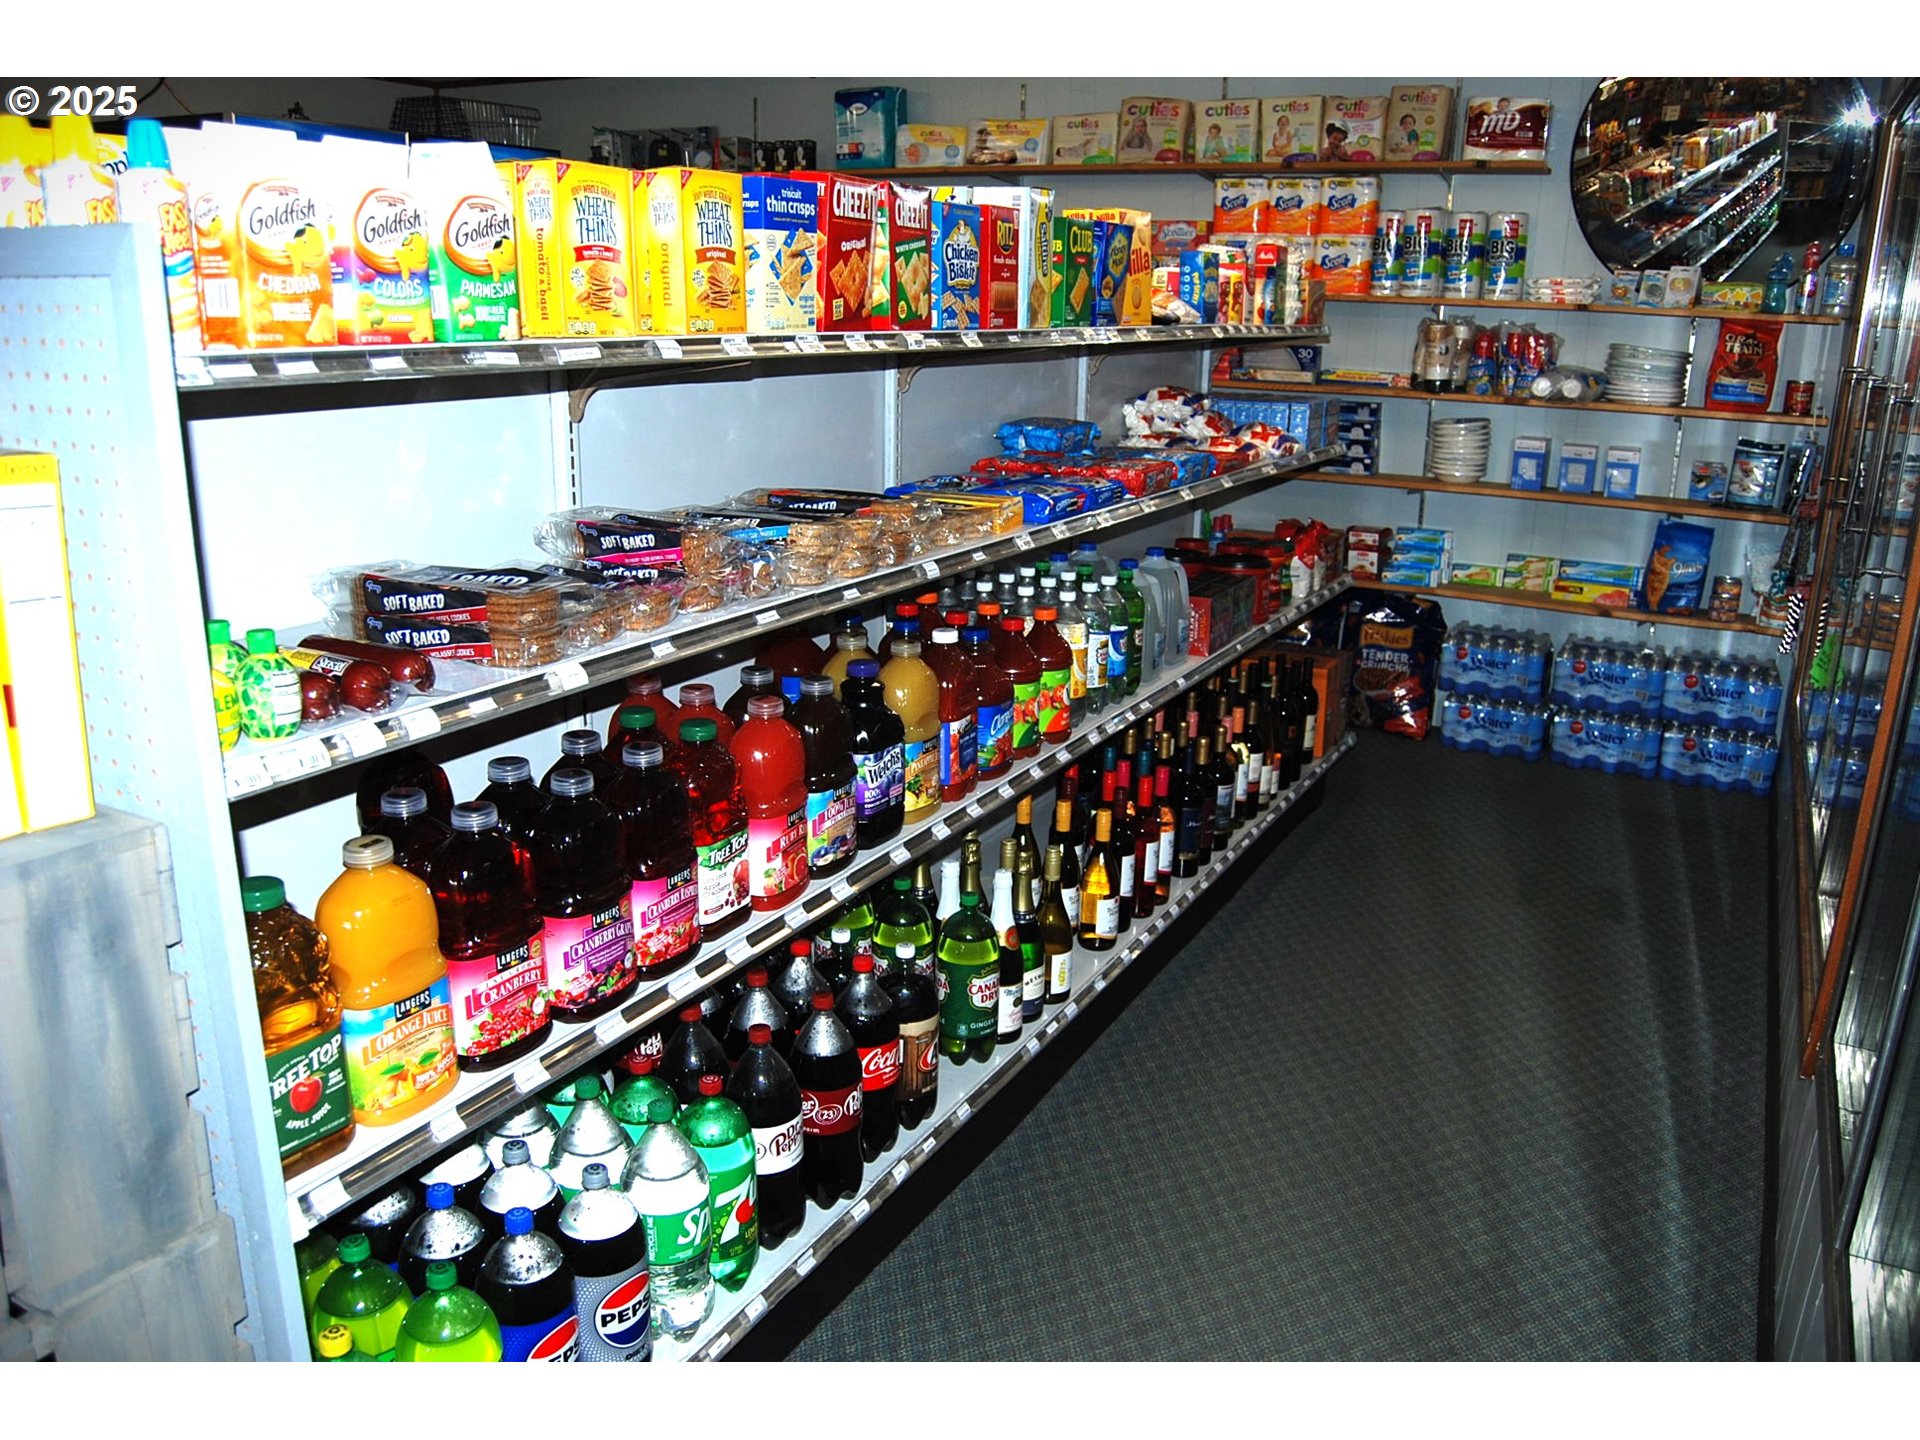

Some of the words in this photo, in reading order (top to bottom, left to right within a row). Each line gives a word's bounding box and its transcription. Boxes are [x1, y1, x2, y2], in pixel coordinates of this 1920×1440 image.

[1272, 101, 1310, 114] cuties
[1400, 91, 1439, 103] cuties
[1128, 101, 1179, 118] cuties
[1205, 102, 1250, 118] cuties
[1067, 118, 1099, 130] cuties
[583, 184, 599, 196] WHOLE
[781, 188, 802, 200] triscuit
[250, 198, 316, 235] Goldfish
[573, 195, 616, 220] WHEAT
[695, 200, 732, 223] WHEAT
[766, 195, 787, 213] thin
[788, 200, 816, 217] crisps
[363, 208, 422, 244] Goldfish
[455, 213, 511, 248] Goldfish
[576, 217, 617, 247] THINS
[697, 221, 732, 247] THINS
[996, 220, 1015, 246] RITZ
[536, 227, 546, 275] tomato
[1070, 226, 1093, 255] CLUB
[1404, 235, 1428, 251] BIG
[1490, 240, 1515, 255] BIG
[944, 242, 979, 263] Chicken
[660, 243, 673, 307] original
[948, 261, 976, 282] Biskit
[257, 272, 322, 295] CHEDDAR
[373, 277, 424, 300] COLORS
[460, 279, 517, 299] PARMESAN
[540, 289, 549, 321] basil
[1298, 348, 1313, 359] 30
[1725, 342, 1763, 355] TRAIN
[600, 534, 622, 550] SOFT
[622, 533, 656, 551] BAKED
[384, 594, 407, 612] SOFT
[409, 593, 445, 612] BAKED
[385, 628, 412, 645] SOFT
[413, 628, 451, 648] BAKED
[1364, 628, 1411, 645] Friskies
[1361, 649, 1410, 664] TENDER
[1470, 655, 1511, 671] Water
[1588, 670, 1629, 686] Water
[1701, 685, 1746, 700] Water
[1475, 714, 1514, 730] Water
[1585, 730, 1627, 746] Water
[1699, 748, 1745, 764] Water
[867, 750, 901, 785] Welch's
[824, 801, 845, 821] 100%
[709, 847, 730, 867] TREE
[730, 833, 748, 852] TOP
[780, 830, 798, 849] RUBY
[667, 867, 691, 890] LANGERS
[592, 905, 620, 929] LANGERS
[571, 926, 616, 960] CRANBERRY
[496, 944, 529, 971] LANGERS
[480, 968, 541, 1007] CRANBERRY
[395, 990, 431, 1018] LANGERS
[375, 1016, 422, 1052] ORANGE
[423, 1008, 448, 1030] JUICE
[308, 1033, 343, 1072] TOP
[285, 1117, 311, 1130] APPLE
[310, 1102, 332, 1124] JUICE
[822, 1110, 834, 1120] 23
